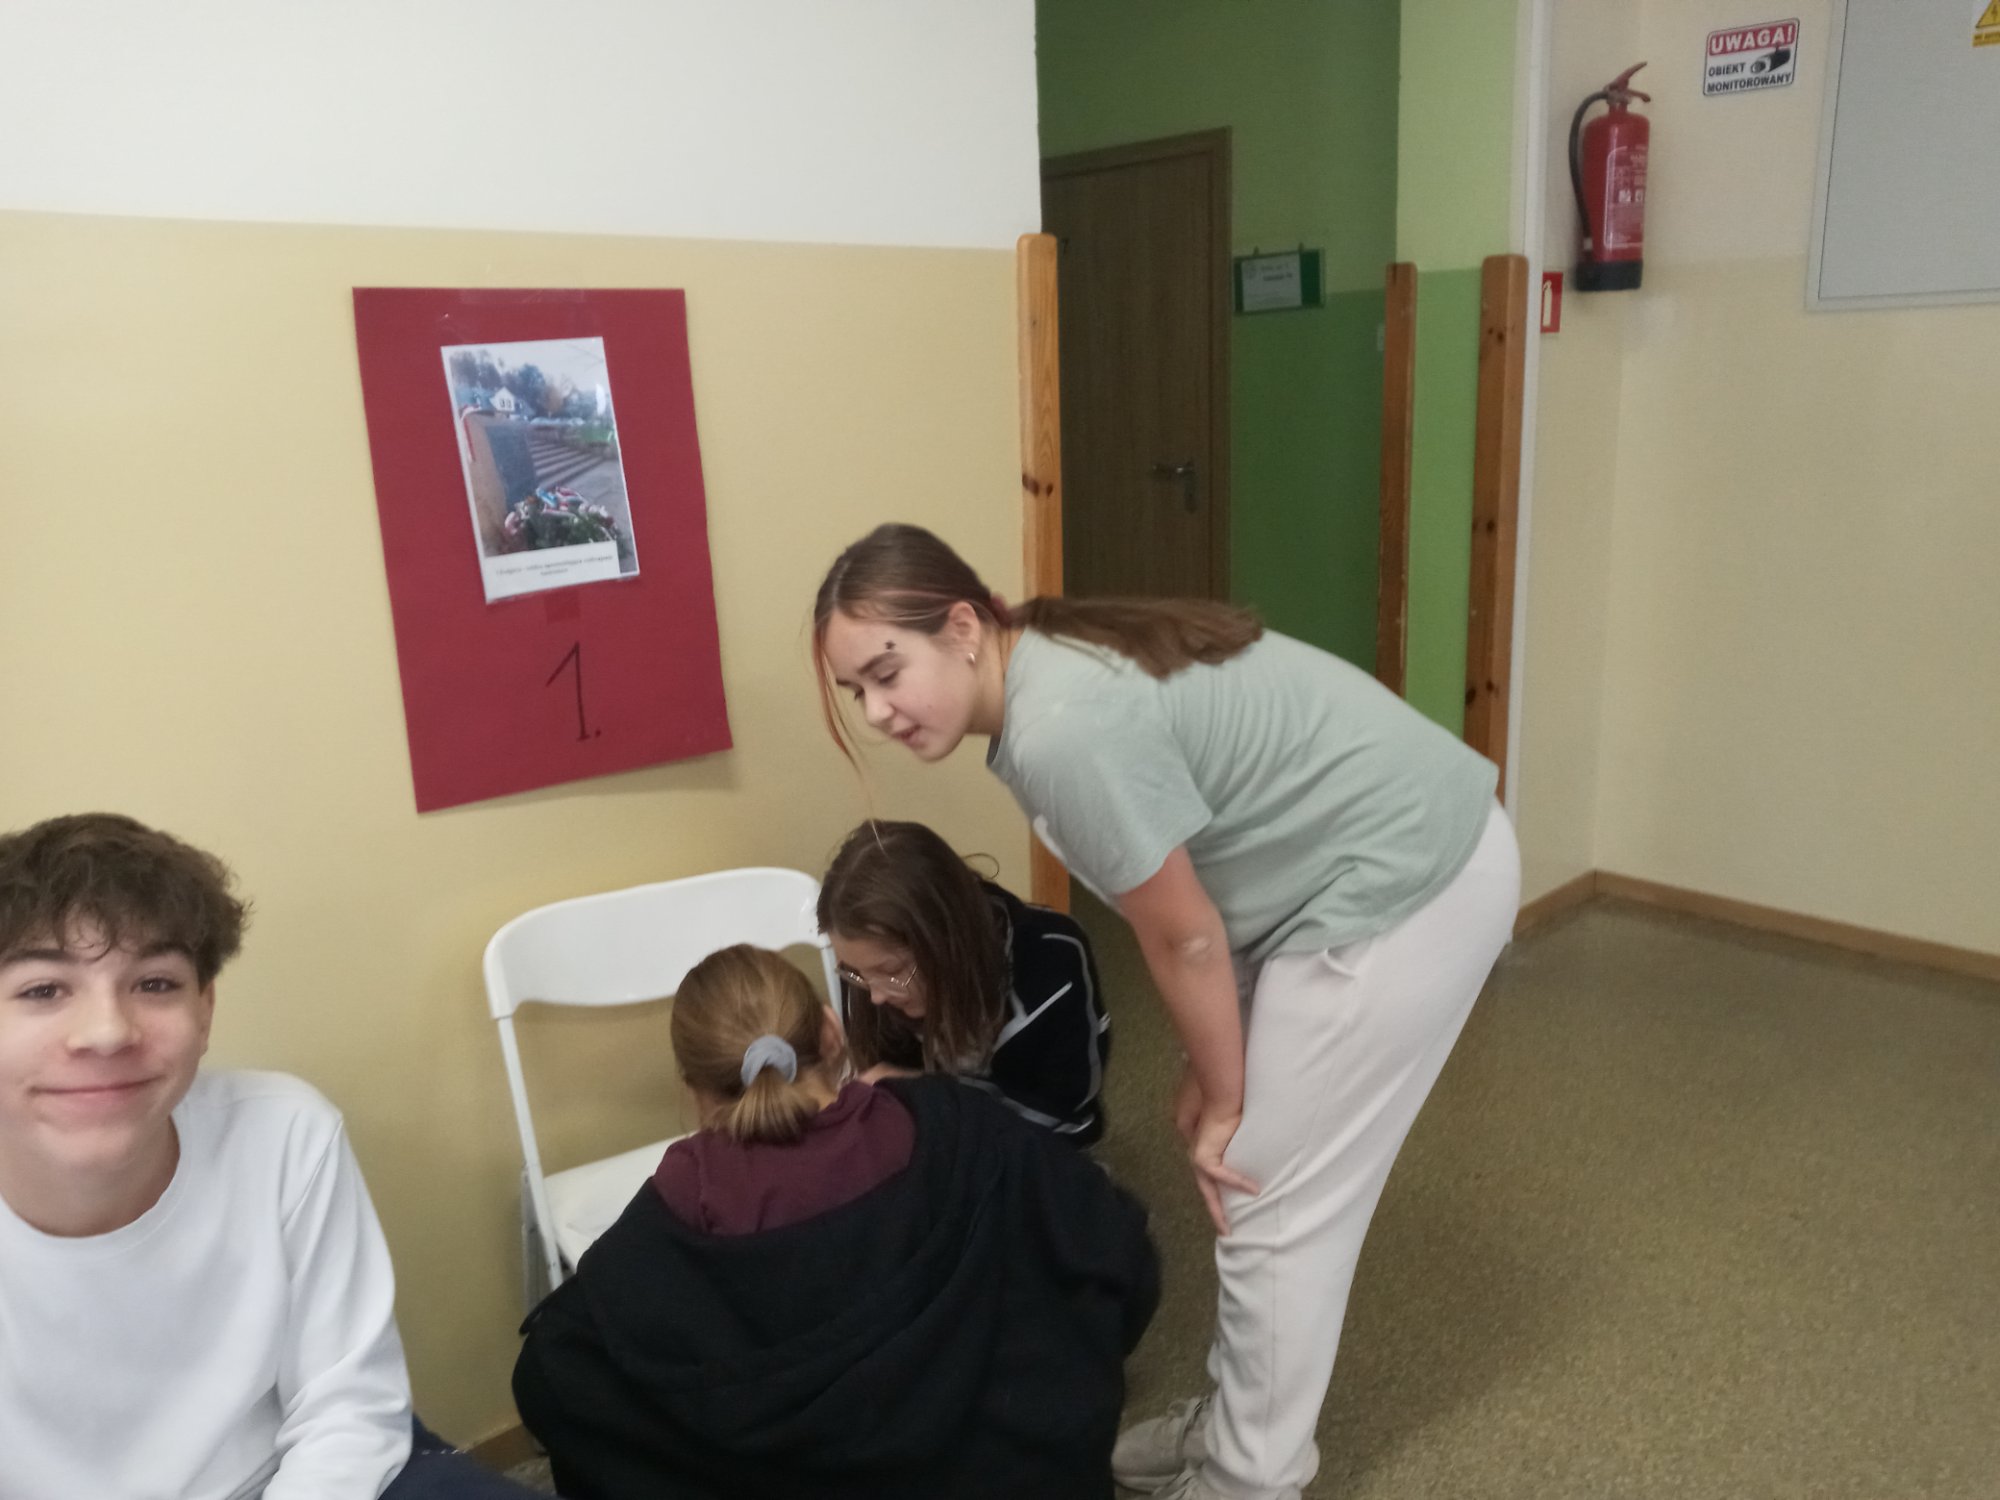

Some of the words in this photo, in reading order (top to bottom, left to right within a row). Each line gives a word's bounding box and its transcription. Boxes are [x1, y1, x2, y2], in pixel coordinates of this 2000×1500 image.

[1711, 25, 1793, 54] UWAGA!
[1708, 62, 1746, 77] OBIEKT
[1706, 73, 1791, 93] MONITOROWANY
[545, 640, 602, 742] 1.
